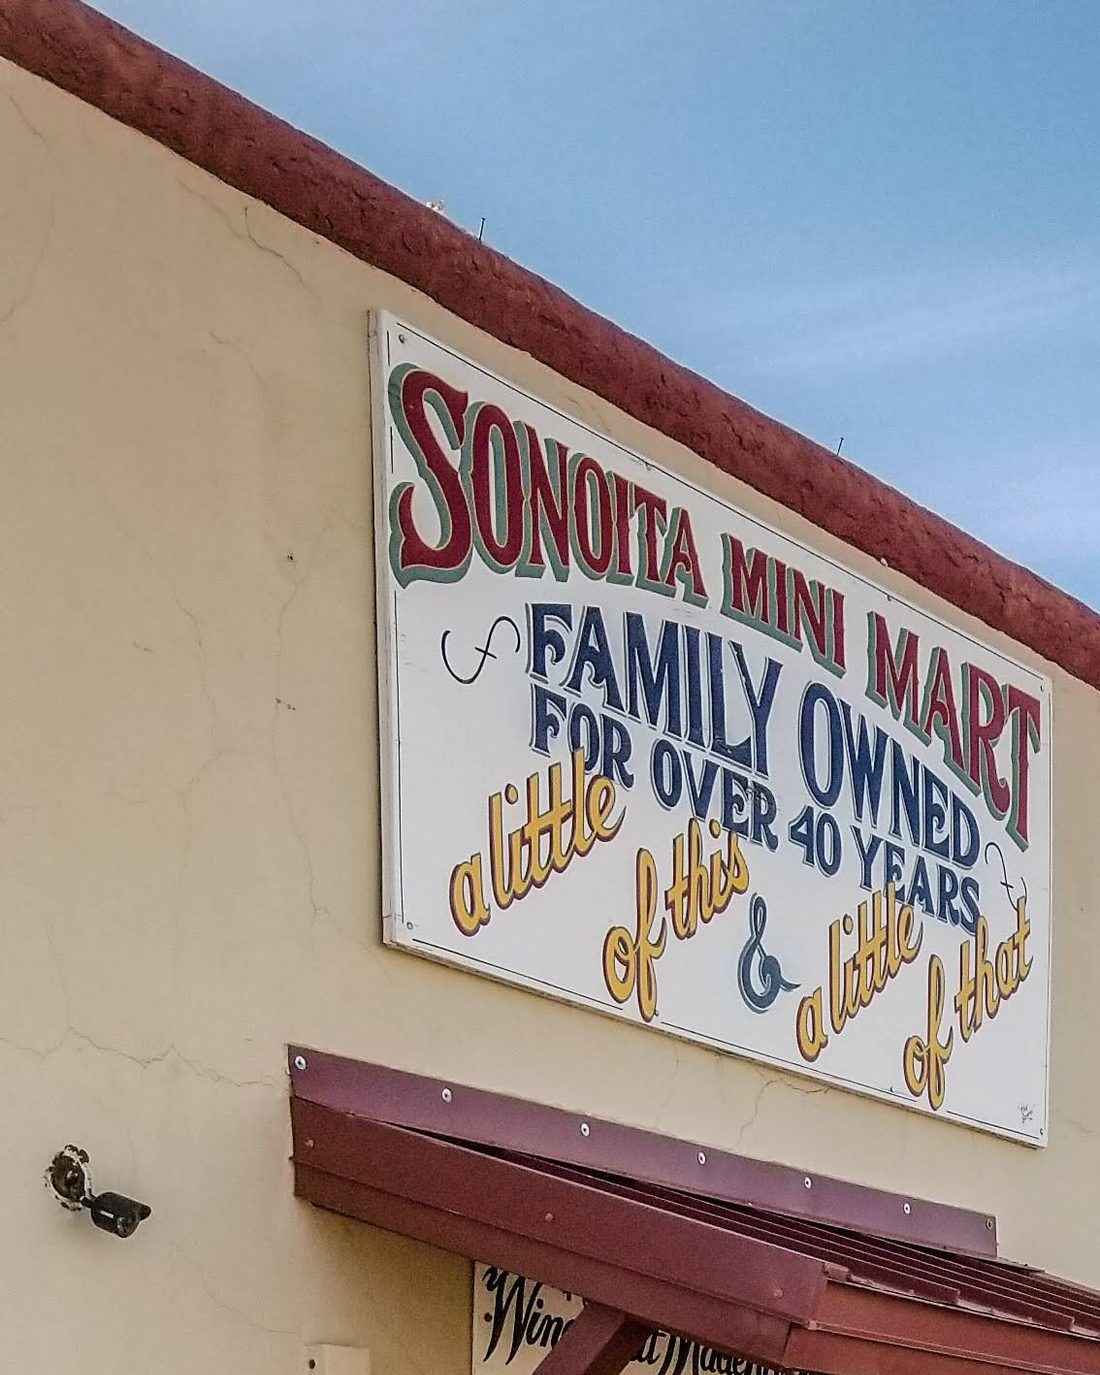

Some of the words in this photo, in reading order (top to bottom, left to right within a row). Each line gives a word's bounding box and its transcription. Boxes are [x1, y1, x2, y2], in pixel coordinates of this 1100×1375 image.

[389, 362, 708, 606] SONOITA
[721, 531, 847, 682] MINI
[866, 610, 1042, 854] MART
[524, 602, 783, 777] FAMILY
[801, 682, 980, 871] OWNED
[528, 686, 634, 791] FOR
[651, 737, 779, 852] OVER
[788, 807, 842, 878] 40
[853, 820, 981, 934] YEARS
[450, 860, 491, 938] a
[489, 748, 626, 912] little
[602, 847, 668, 1025] of
[664, 816, 750, 934] this
[737, 892, 800, 1014] &
[795, 985, 830, 1063] a
[828, 881, 925, 1037] little
[902, 954, 955, 1112] of
[954, 897, 1035, 1043] that
[482, 1266, 576, 1366] Win
